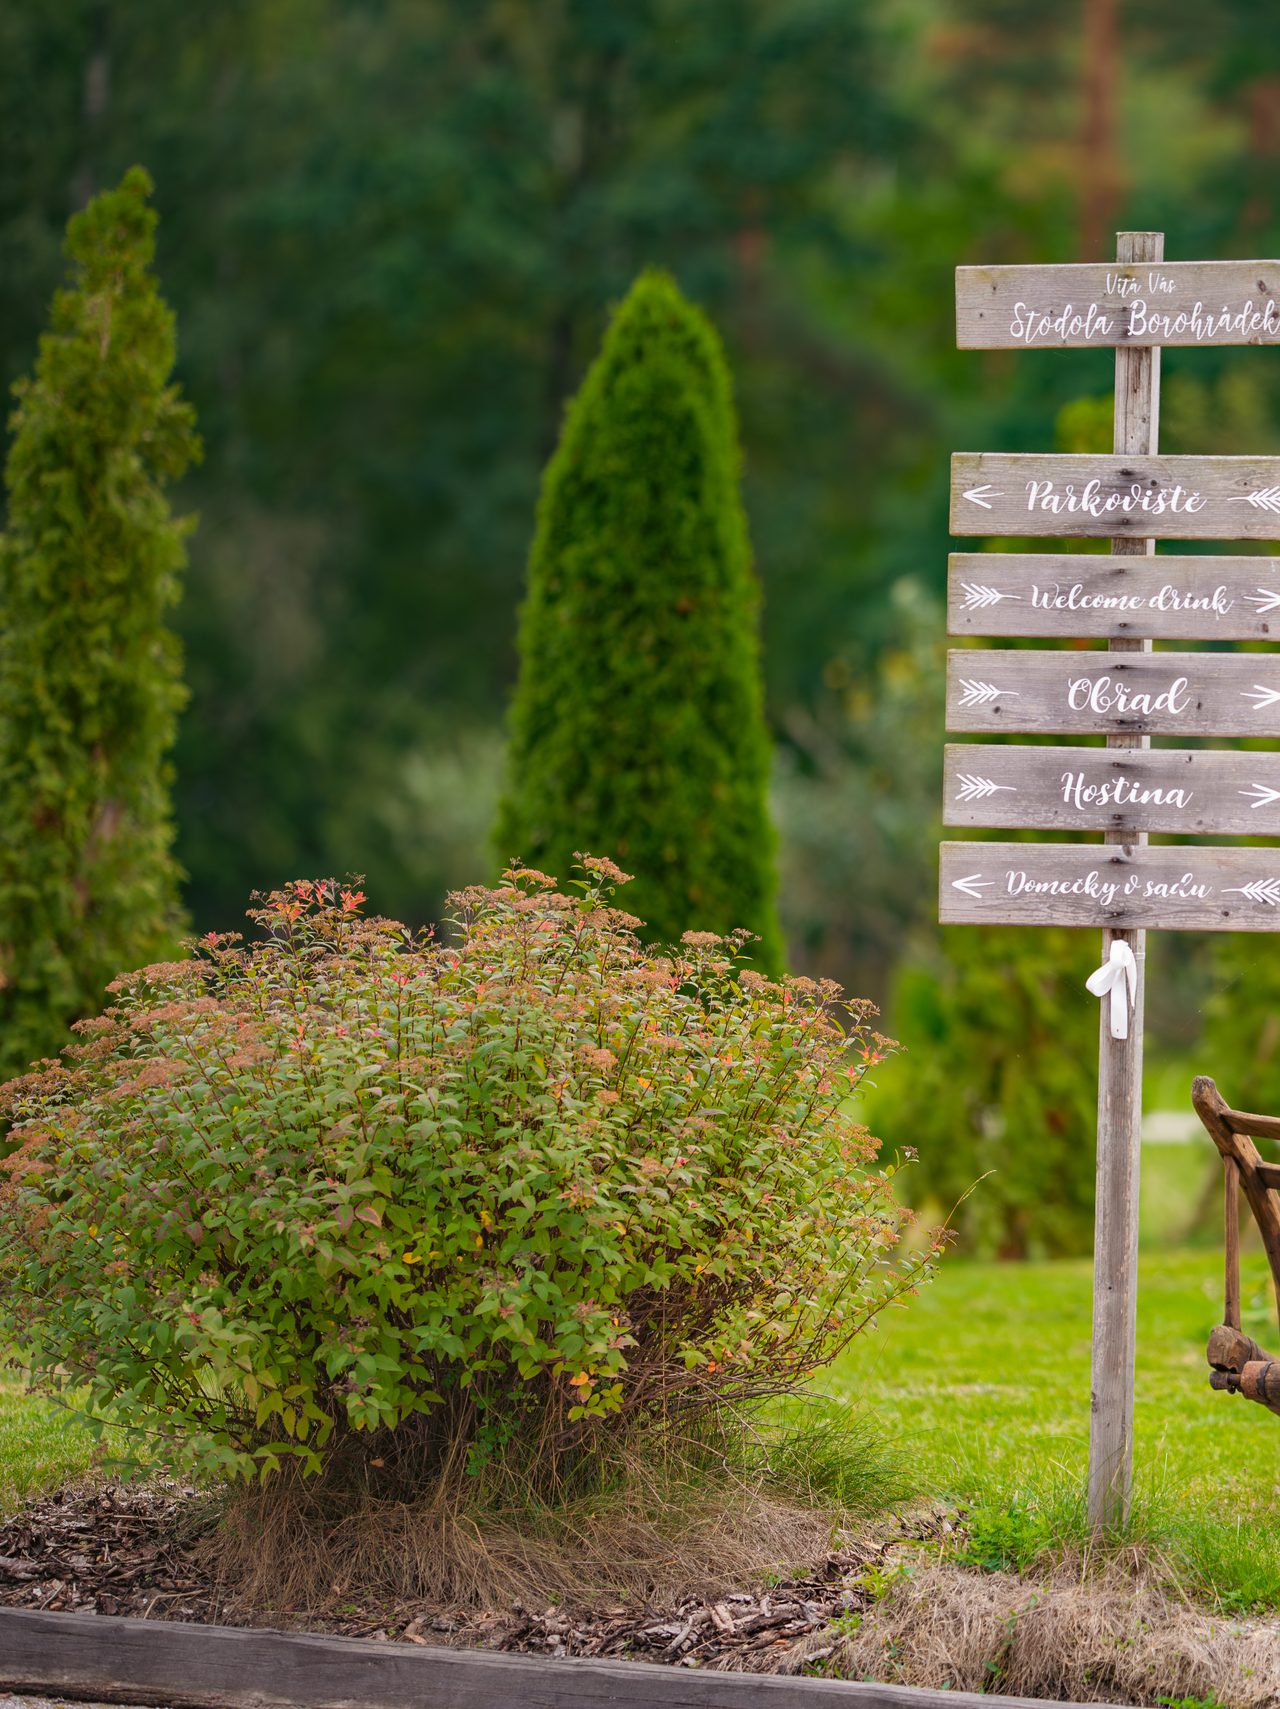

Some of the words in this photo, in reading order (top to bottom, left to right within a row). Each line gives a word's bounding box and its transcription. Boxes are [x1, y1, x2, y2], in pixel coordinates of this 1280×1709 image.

[1106, 273, 1141, 299] Vítá
[1148, 272, 1177, 294] Vás
[1010, 302, 1113, 343] Stodola
[1025, 479, 1208, 517] Parkoviště
[1031, 583, 1146, 610] Welcome
[1148, 584, 1234, 616] drink
[1067, 676, 1191, 714] Obřad
[1061, 772, 1193, 810] Hostina
[1006, 870, 1120, 906] Domečky
[1124, 874, 1142, 895] v
